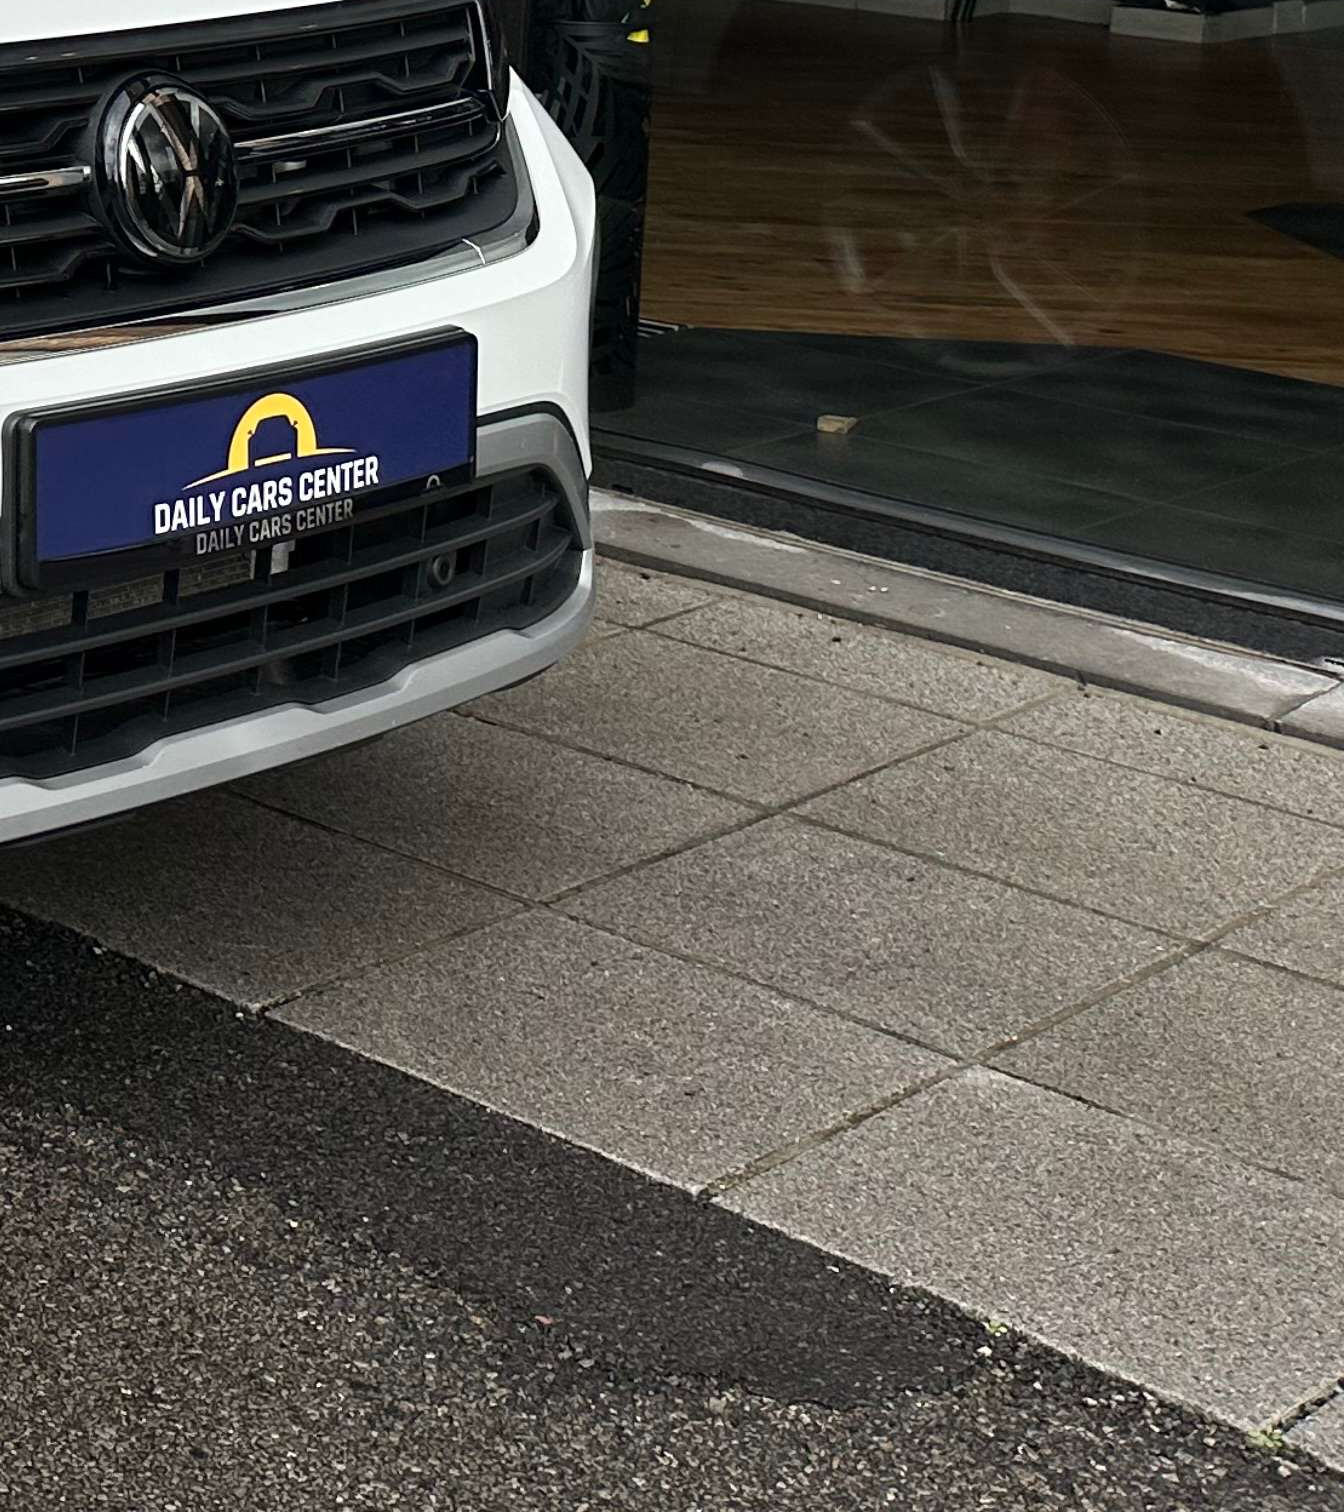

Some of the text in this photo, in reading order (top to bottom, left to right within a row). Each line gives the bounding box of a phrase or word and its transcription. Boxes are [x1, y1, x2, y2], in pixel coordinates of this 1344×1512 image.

[154, 455, 379, 535] DAILY CARS CENTER
[196, 499, 354, 555] DAILY CARS CENTER
